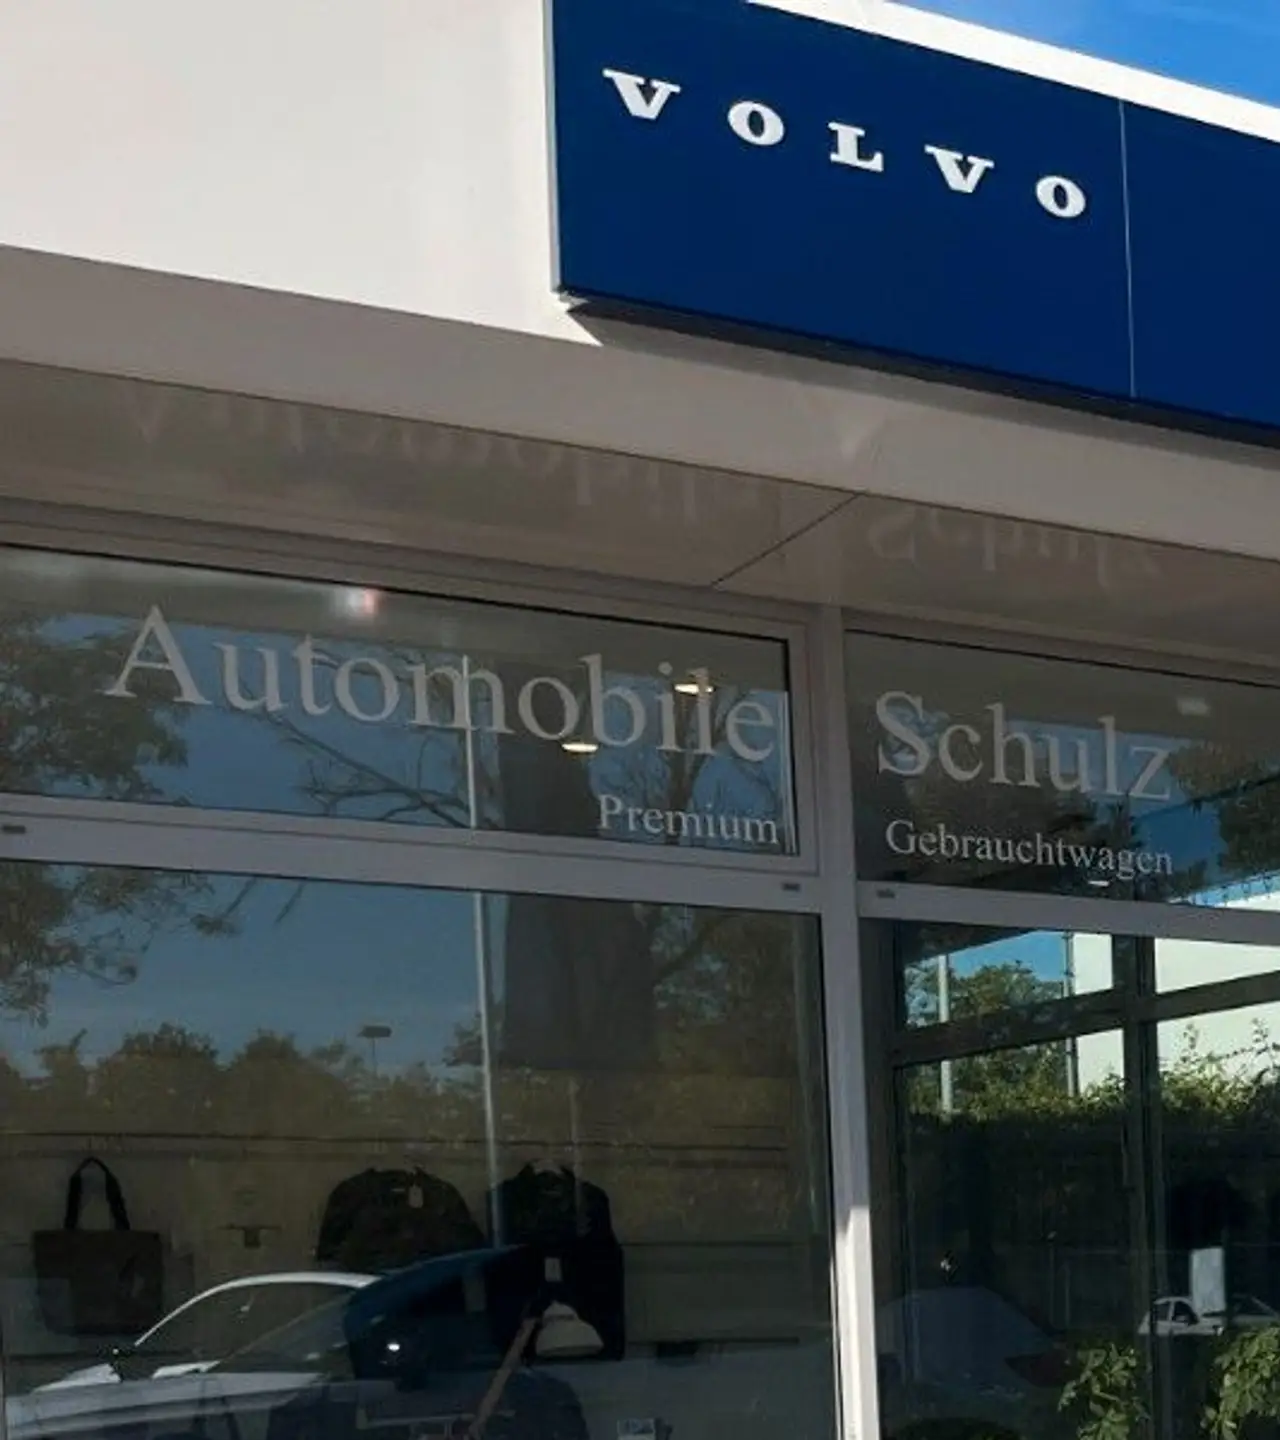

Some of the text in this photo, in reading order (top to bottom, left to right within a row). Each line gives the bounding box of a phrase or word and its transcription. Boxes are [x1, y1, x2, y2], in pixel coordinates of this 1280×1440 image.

[603, 68, 1086, 218] VOLVO
[98, 603, 1171, 800] Automobile Schulz
[598, 793, 782, 845] Premium
[885, 819, 1173, 880] Gebrauchtwagen
